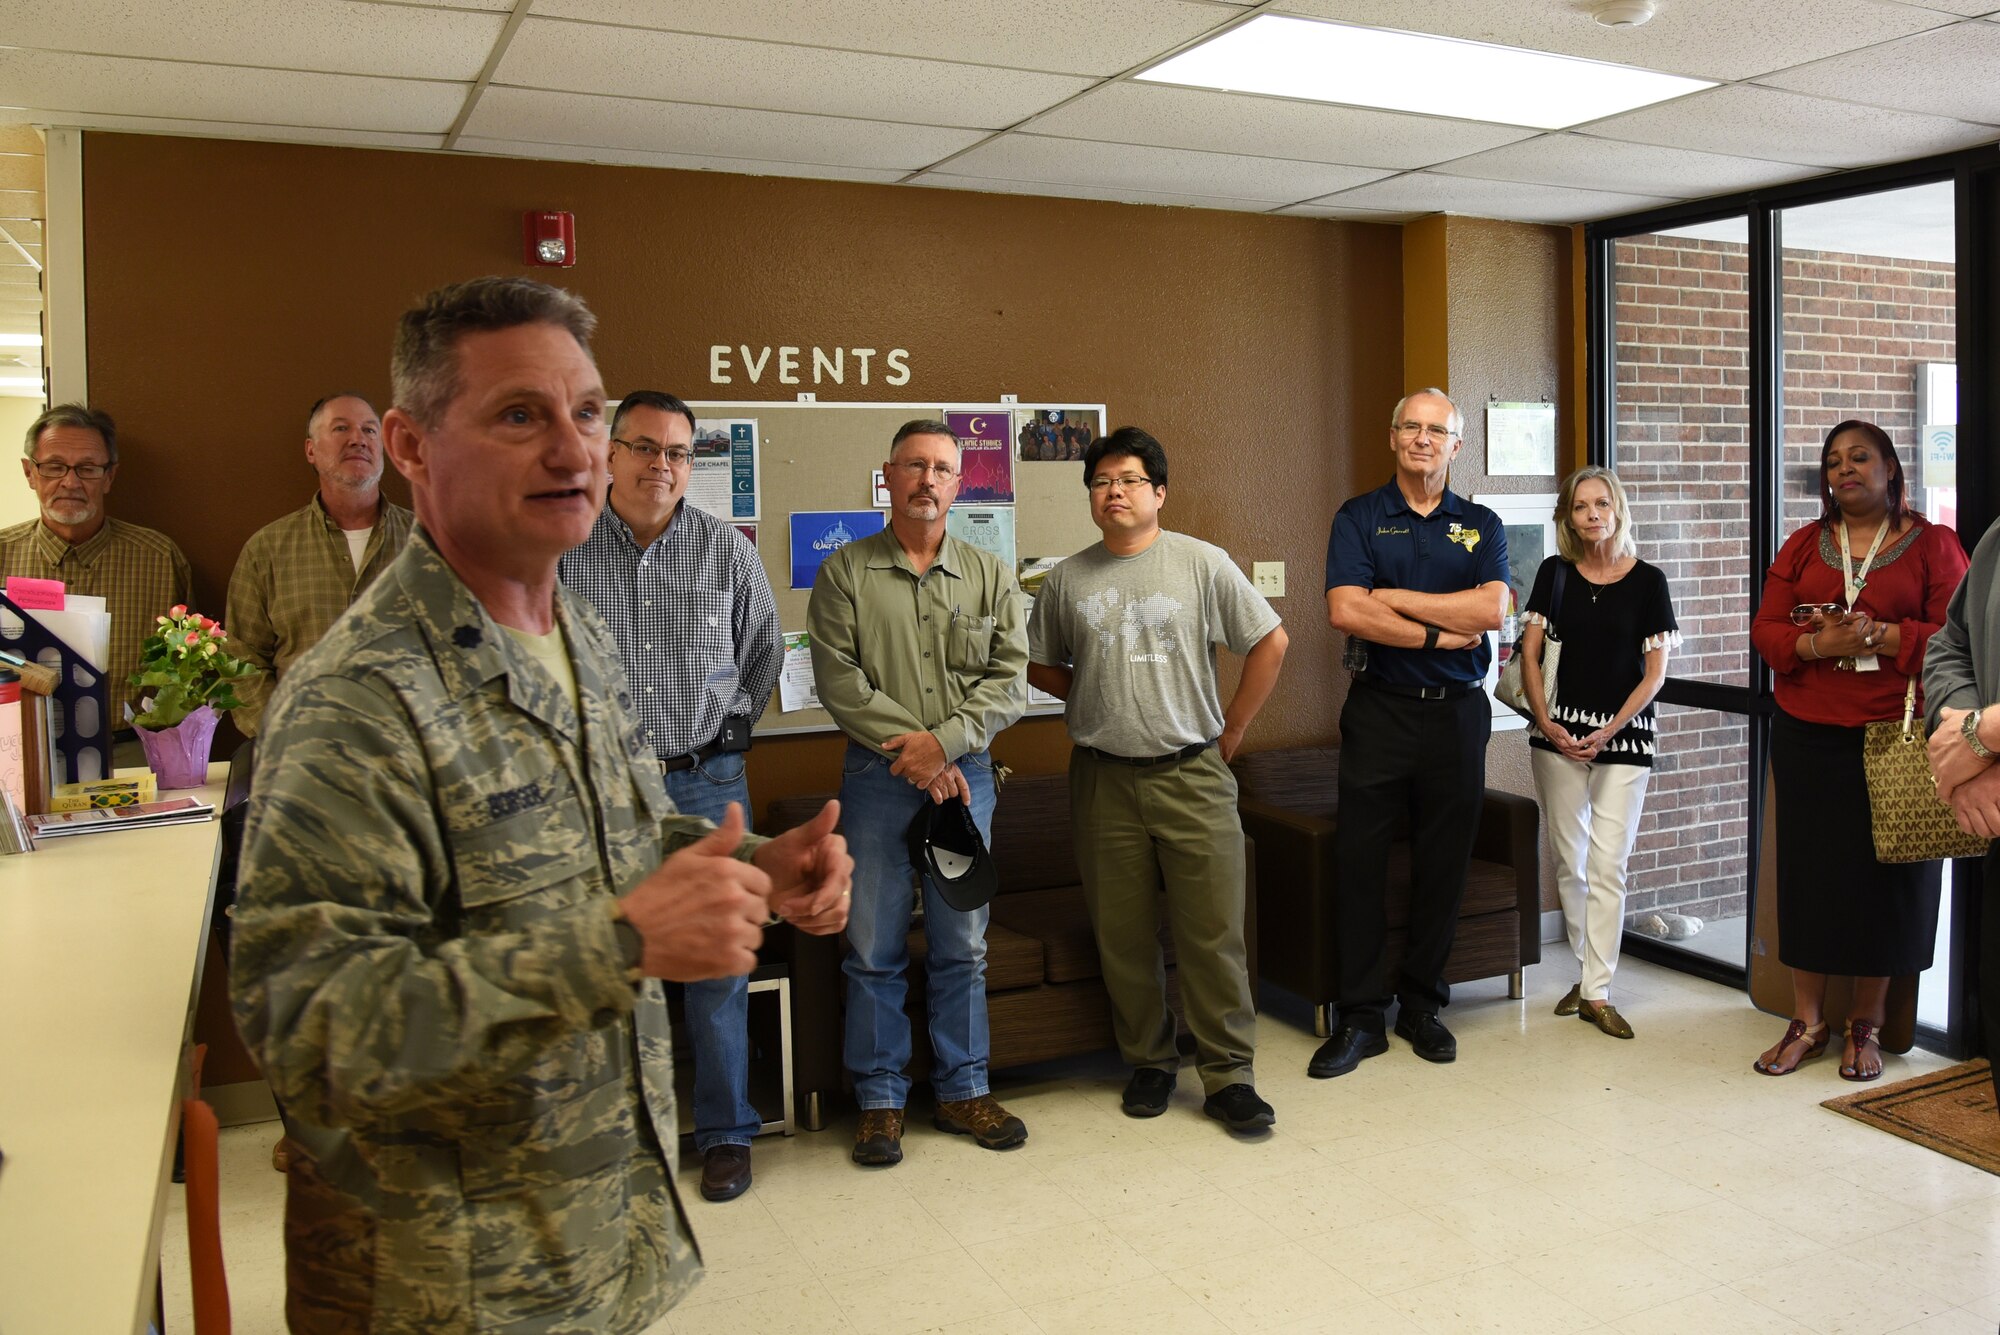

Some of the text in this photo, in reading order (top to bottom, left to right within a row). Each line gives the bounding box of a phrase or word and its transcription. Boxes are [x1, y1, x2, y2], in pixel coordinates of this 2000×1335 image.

[710, 344, 911, 386] EVENTS
[979, 439, 1002, 447] STUDIES
[962, 525, 1000, 536] CROSS
[1448, 523, 1463, 533] 75
[966, 536, 996, 546] TALK
[1130, 654, 1168, 664] LIMITLESS
[1885, 734, 1900, 744] MK
[1893, 744, 1911, 755] MK
[1912, 742, 1928, 752] MK
[1884, 754, 1921, 766] MK MK
[1893, 764, 1931, 776] MK MK
[1884, 775, 1921, 787] MK MK
[1894, 786, 1931, 798] MK MK
[62, 801, 88, 809] QURAN
[1885, 798, 1943, 810] MK MK MK
[1894, 808, 1953, 820] MK MK MK
[1886, 822, 1903, 832] MK
[1905, 821, 1923, 831] MK
[1924, 820, 1943, 830] MK
[1896, 831, 1953, 844] MK MK MK
[1887, 838, 1982, 855] MK MK MK MK MK
